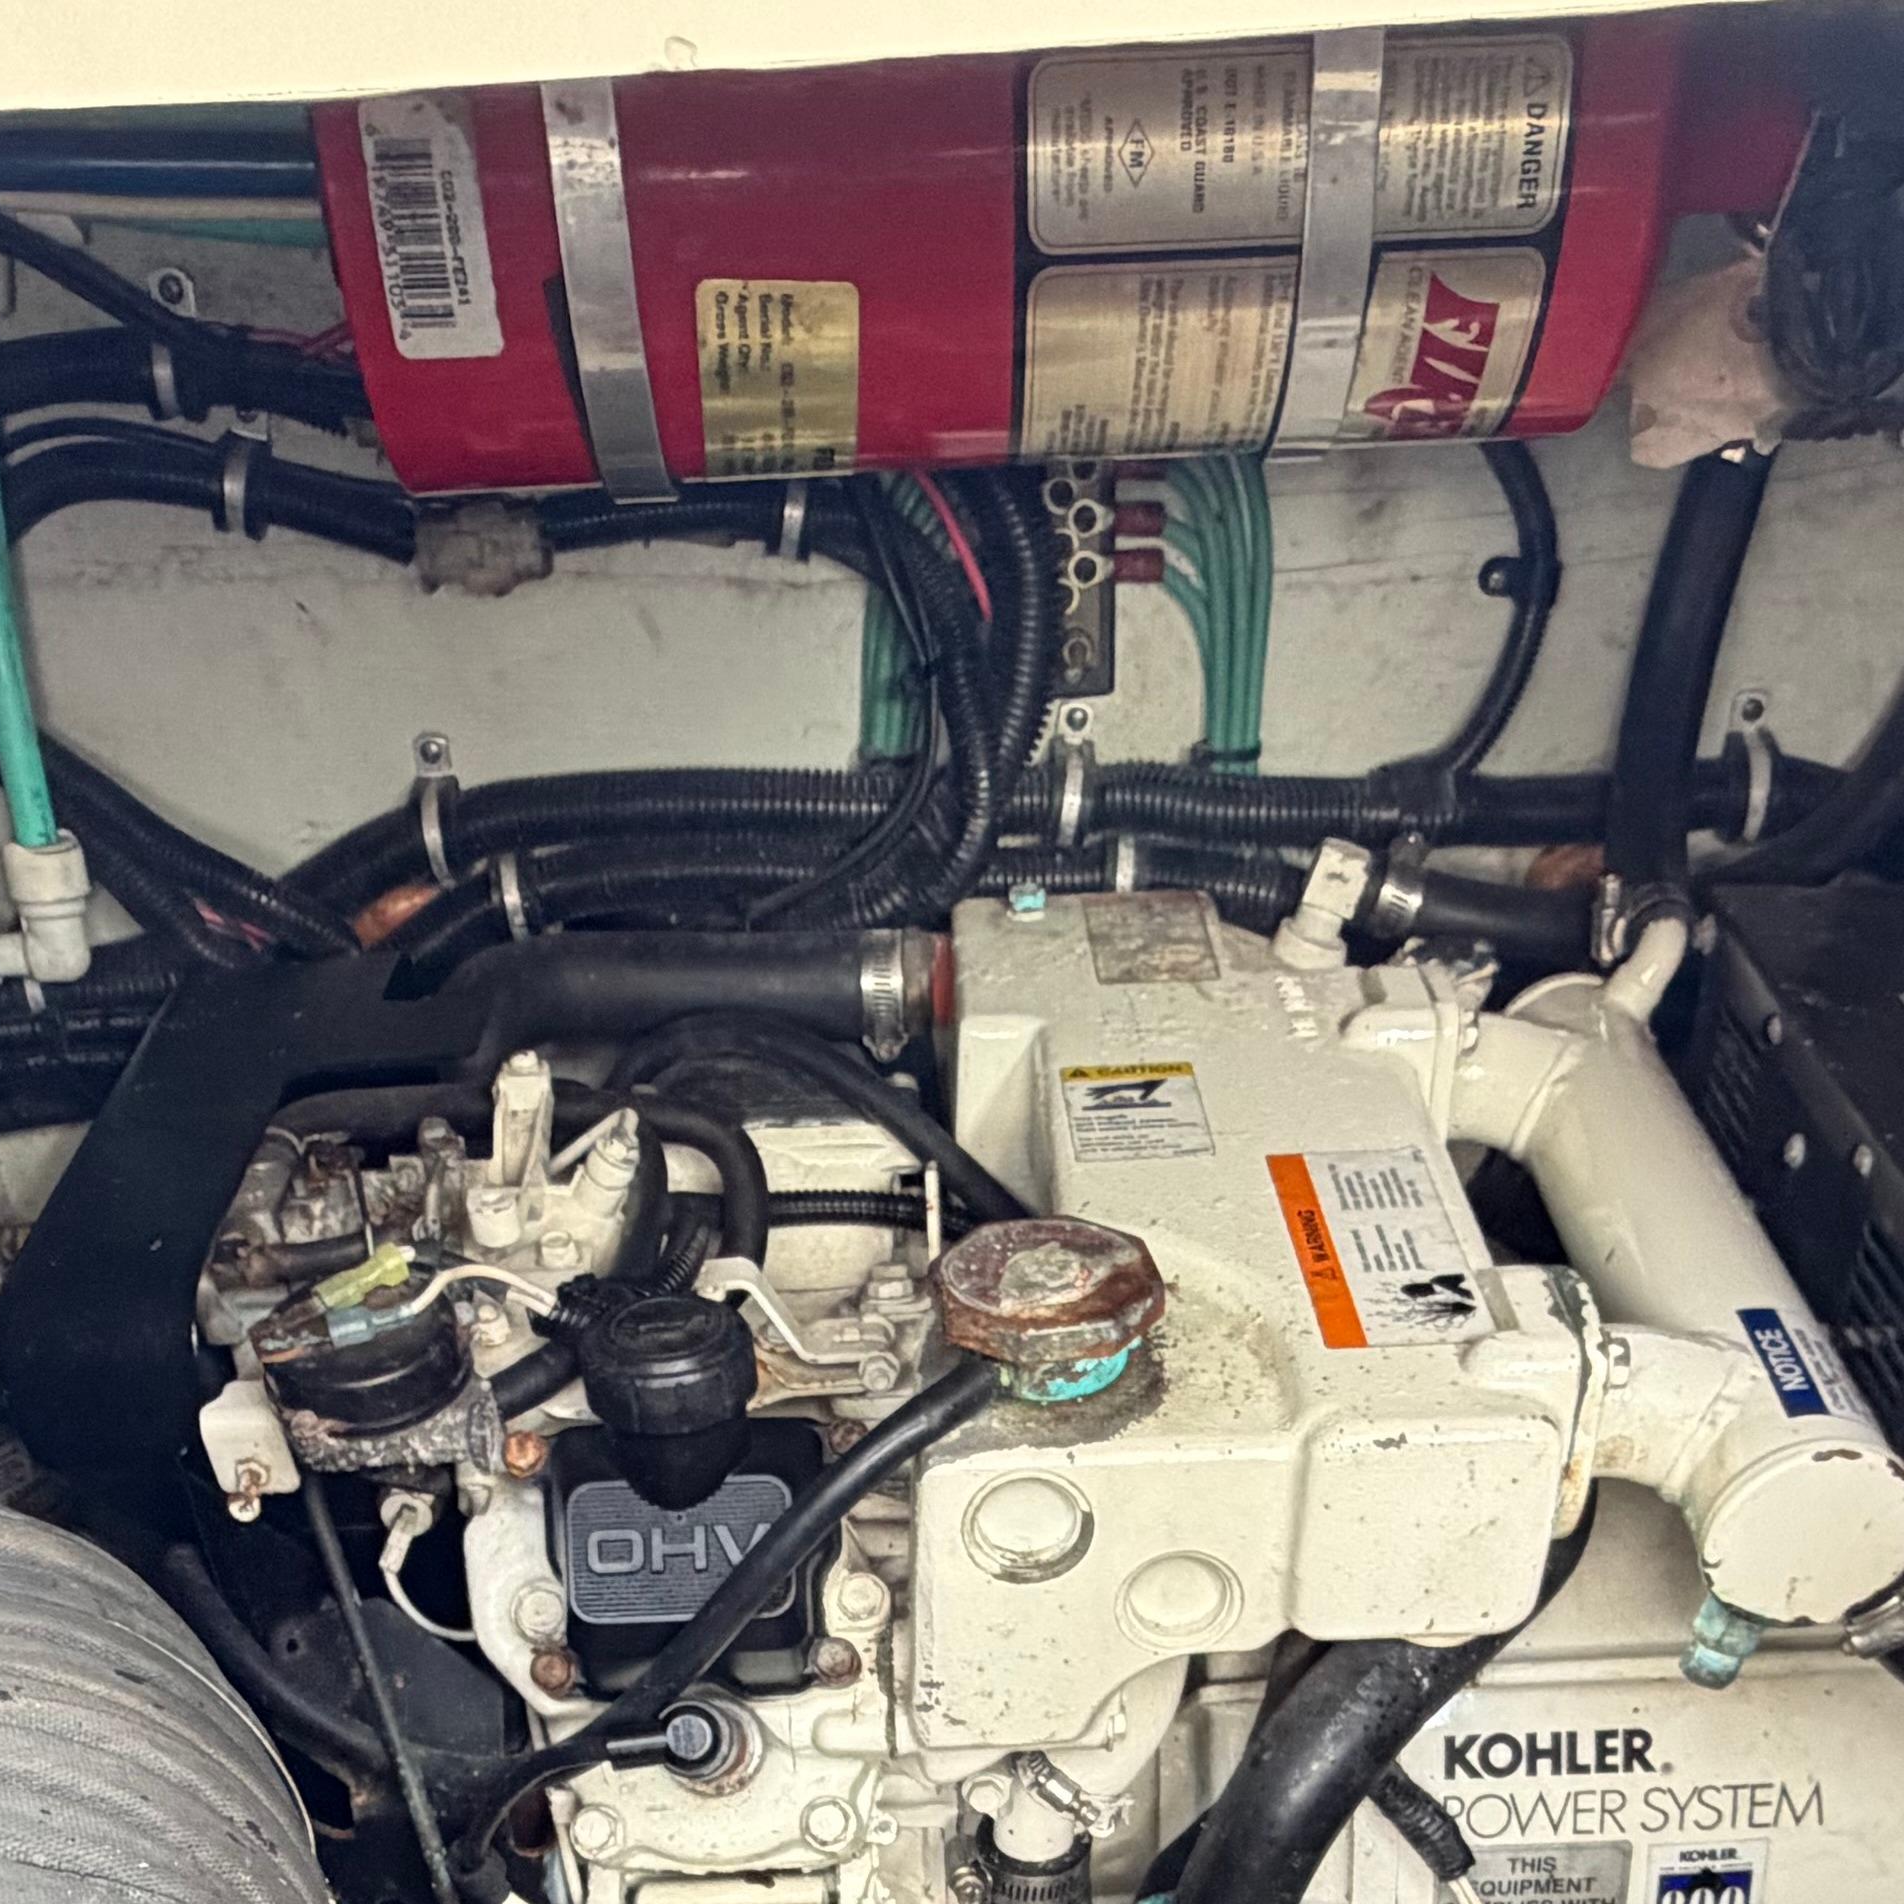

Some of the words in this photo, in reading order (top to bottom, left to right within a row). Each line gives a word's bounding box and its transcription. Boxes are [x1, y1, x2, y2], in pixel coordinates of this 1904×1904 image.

[1179, 68, 1194, 152] APPROVED
[1192, 105, 1208, 156] COAST
[1127, 139, 1146, 169] FM
[1517, 101, 1549, 211] DANGER
[1191, 161, 1206, 214] GUARD
[1400, 266, 1423, 331] CLEAN
[1392, 333, 1411, 385] AGENT
[1096, 1062, 1184, 1077] CAUTION
[1297, 1208, 1331, 1264] WARNING
[1753, 1327, 1810, 1392] NOTICE
[586, 1523, 772, 1575] OHV
[1442, 1728, 1657, 1781] KOHLER
[1442, 1789, 1627, 1839] POWER
[1639, 1781, 1825, 1833] SYSTEM
[1507, 1856, 1558, 1874] THIS
[1679, 1847, 1738, 1863] KOHLER
